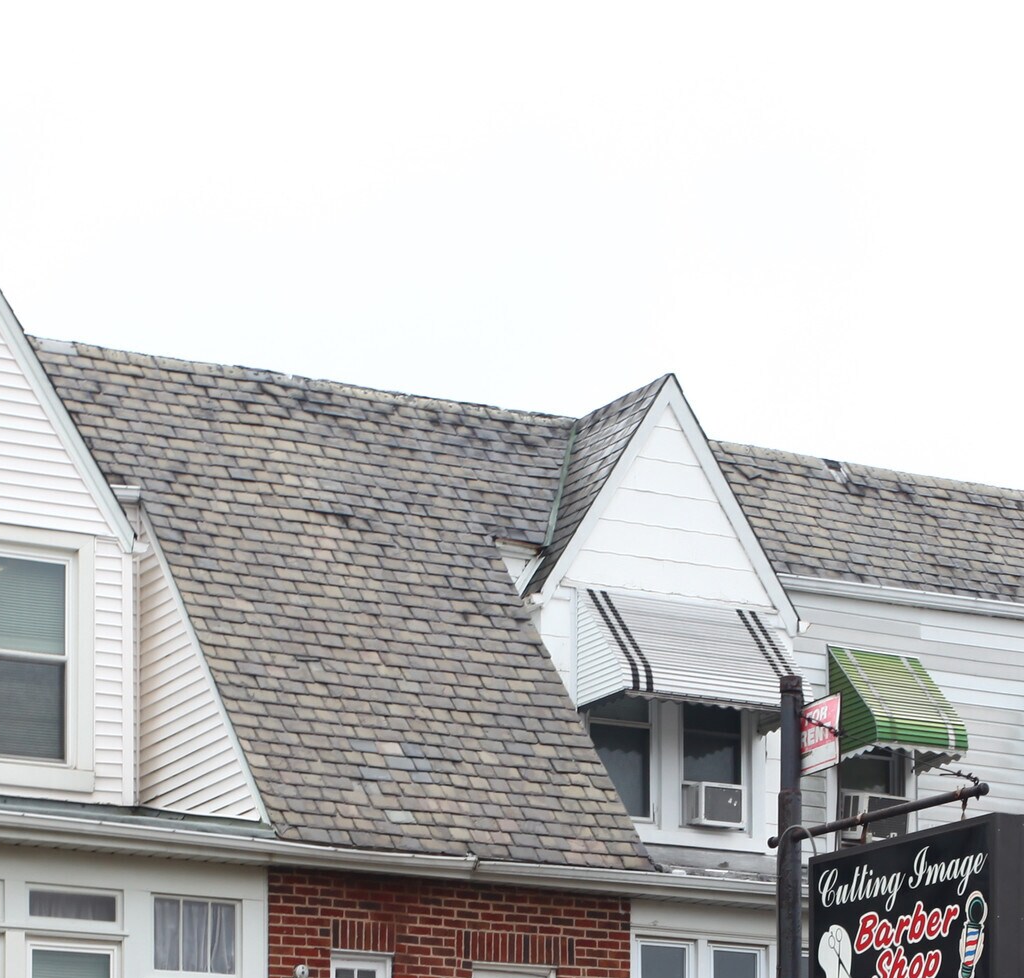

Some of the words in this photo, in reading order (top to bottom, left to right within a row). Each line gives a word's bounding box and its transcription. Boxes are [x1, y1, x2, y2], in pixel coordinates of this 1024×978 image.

[801, 721, 832, 749] RENT
[804, 705, 828, 727] FOR
[818, 864, 906, 912] Cutting
[908, 846, 988, 896] Image
[854, 901, 960, 954] Barber
